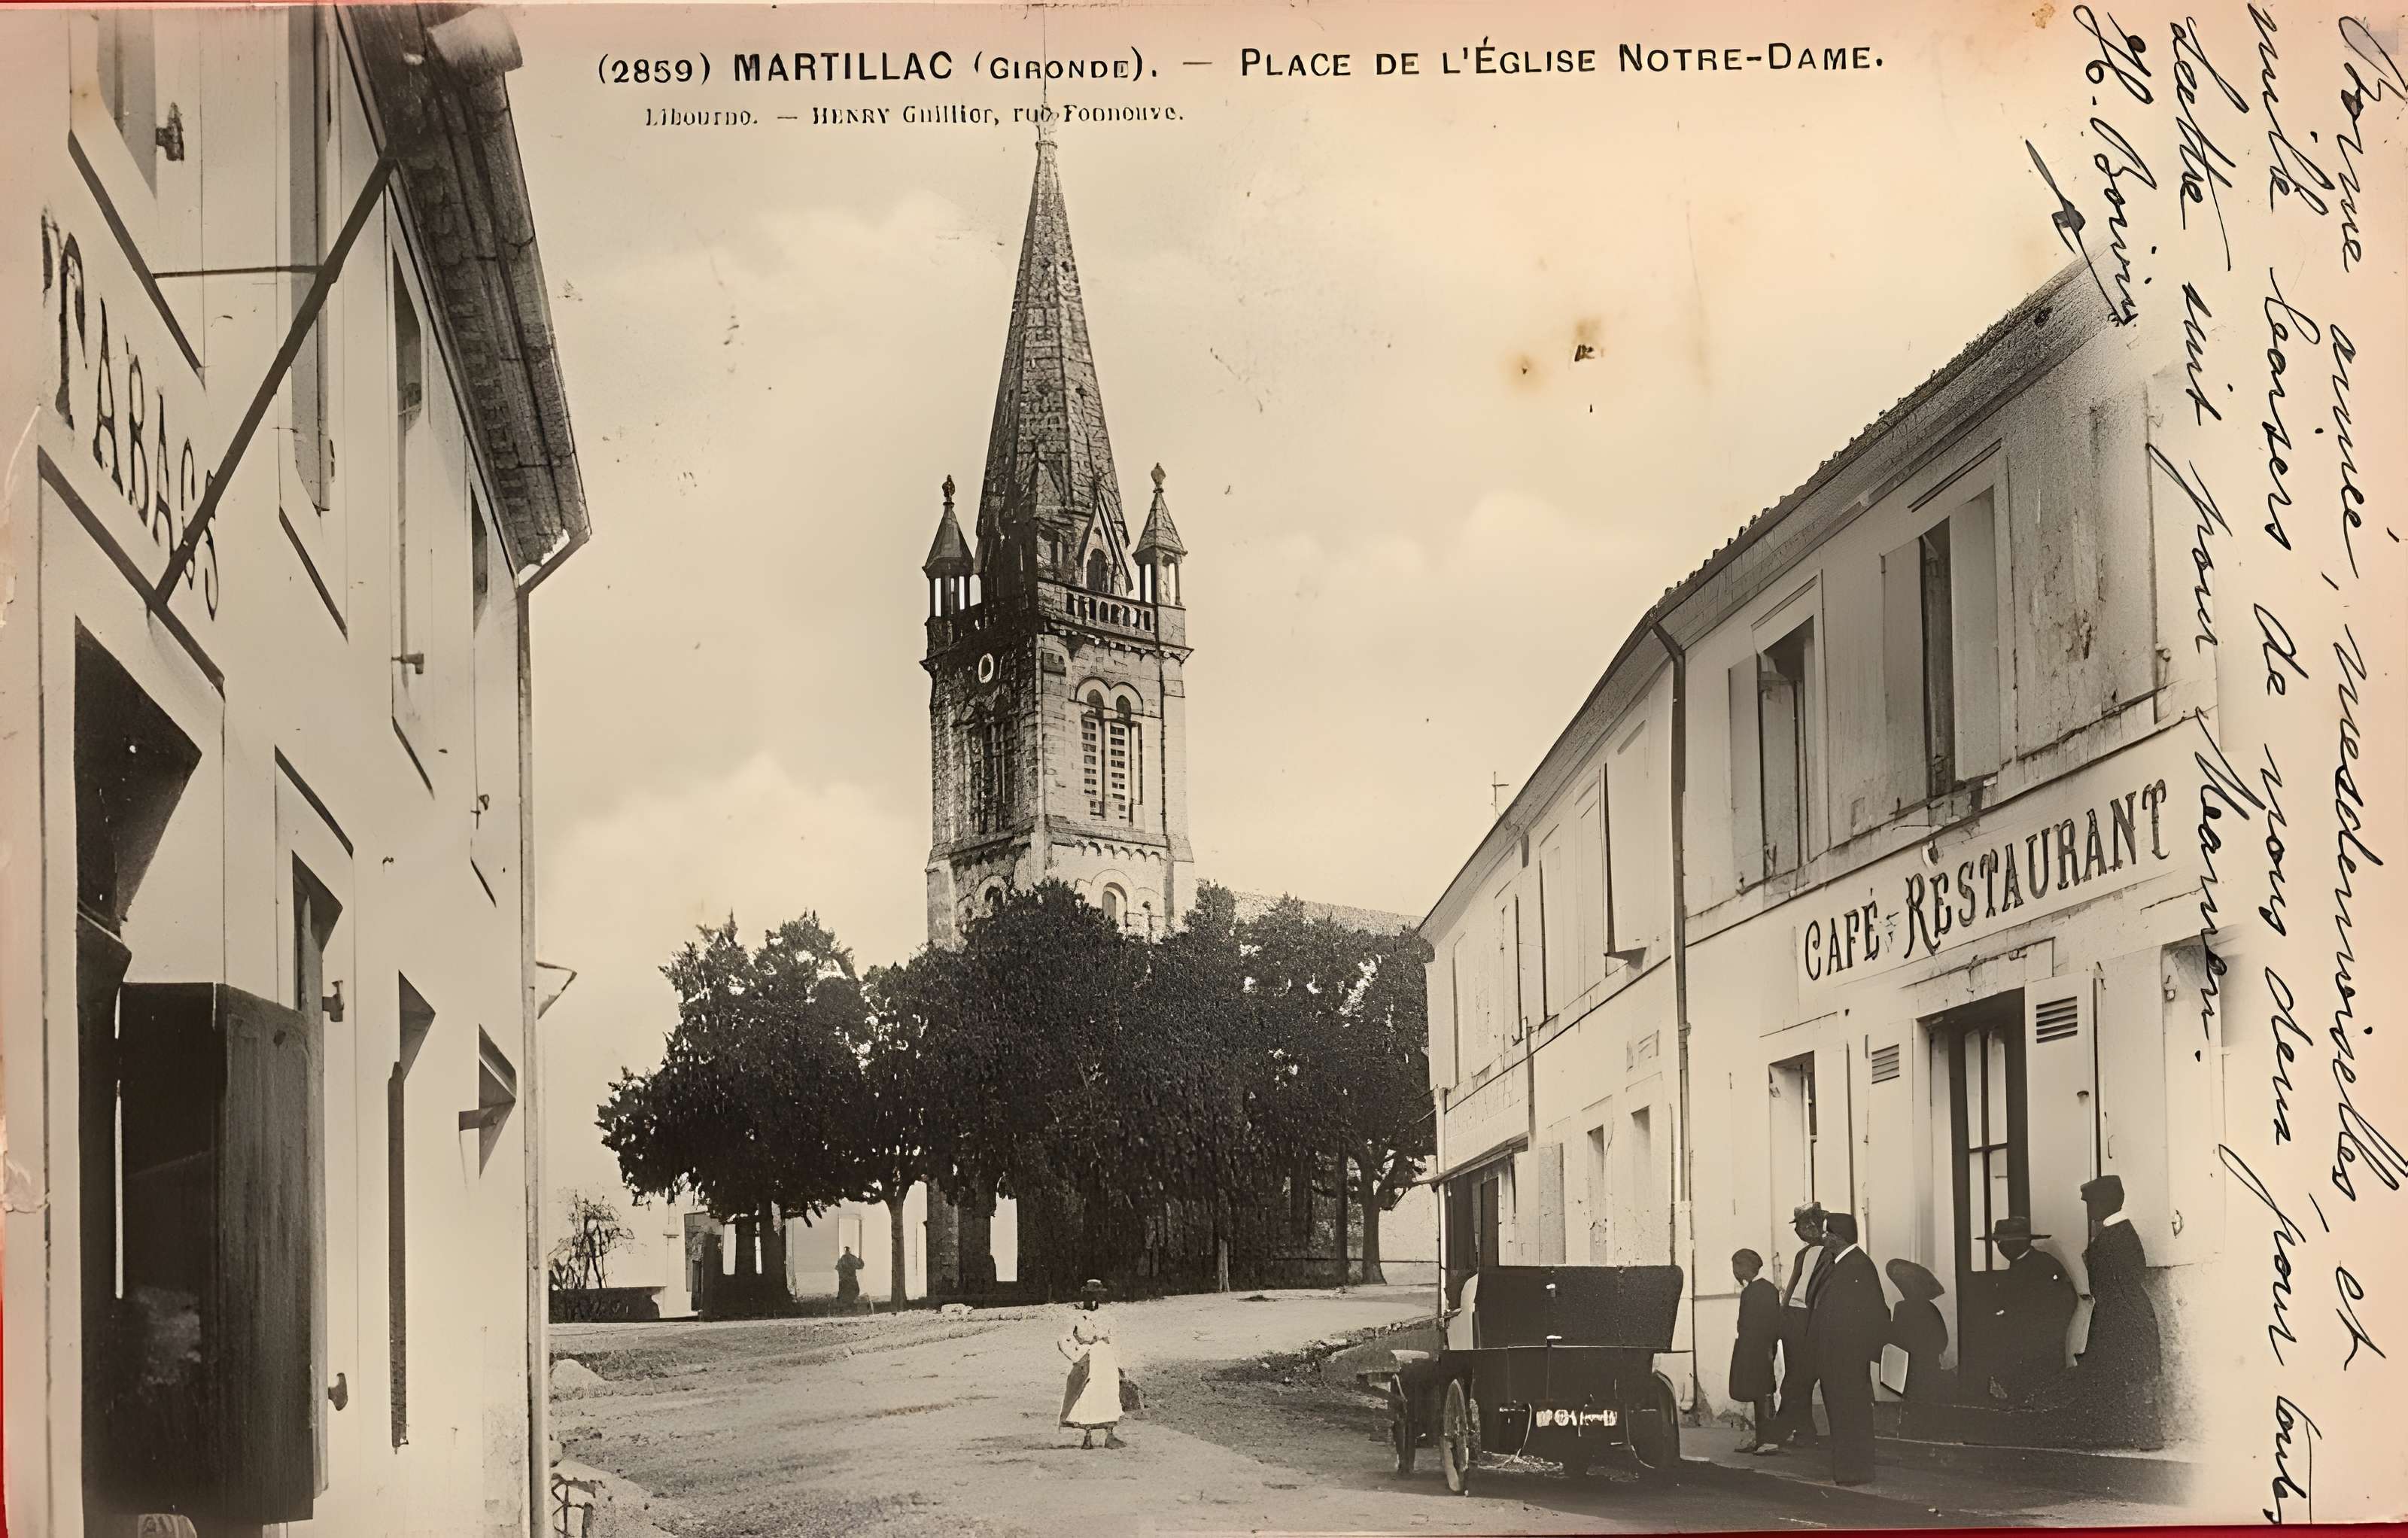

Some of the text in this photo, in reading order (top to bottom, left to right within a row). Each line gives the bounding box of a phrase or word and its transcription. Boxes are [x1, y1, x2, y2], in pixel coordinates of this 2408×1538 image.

[2072, 4, 2155, 107] H.
[2169, 17, 2249, 272] Lettre
[2246, 2, 2336, 214] mille
[2337, 15, 2408, 274] Bonne
[2181, 283, 2234, 427] suit
[2260, 266, 2325, 552] baisers
[2145, 442, 2233, 656] pour
[2252, 602, 2310, 697] de
[1803, 777, 2171, 981] CAFÉ RESTAURANT
[2258, 743, 2288, 938] nous
[2270, 965, 2315, 1147] deux
[2218, 1142, 2308, 1366] pour
[2335, 1264, 2387, 1372] et
